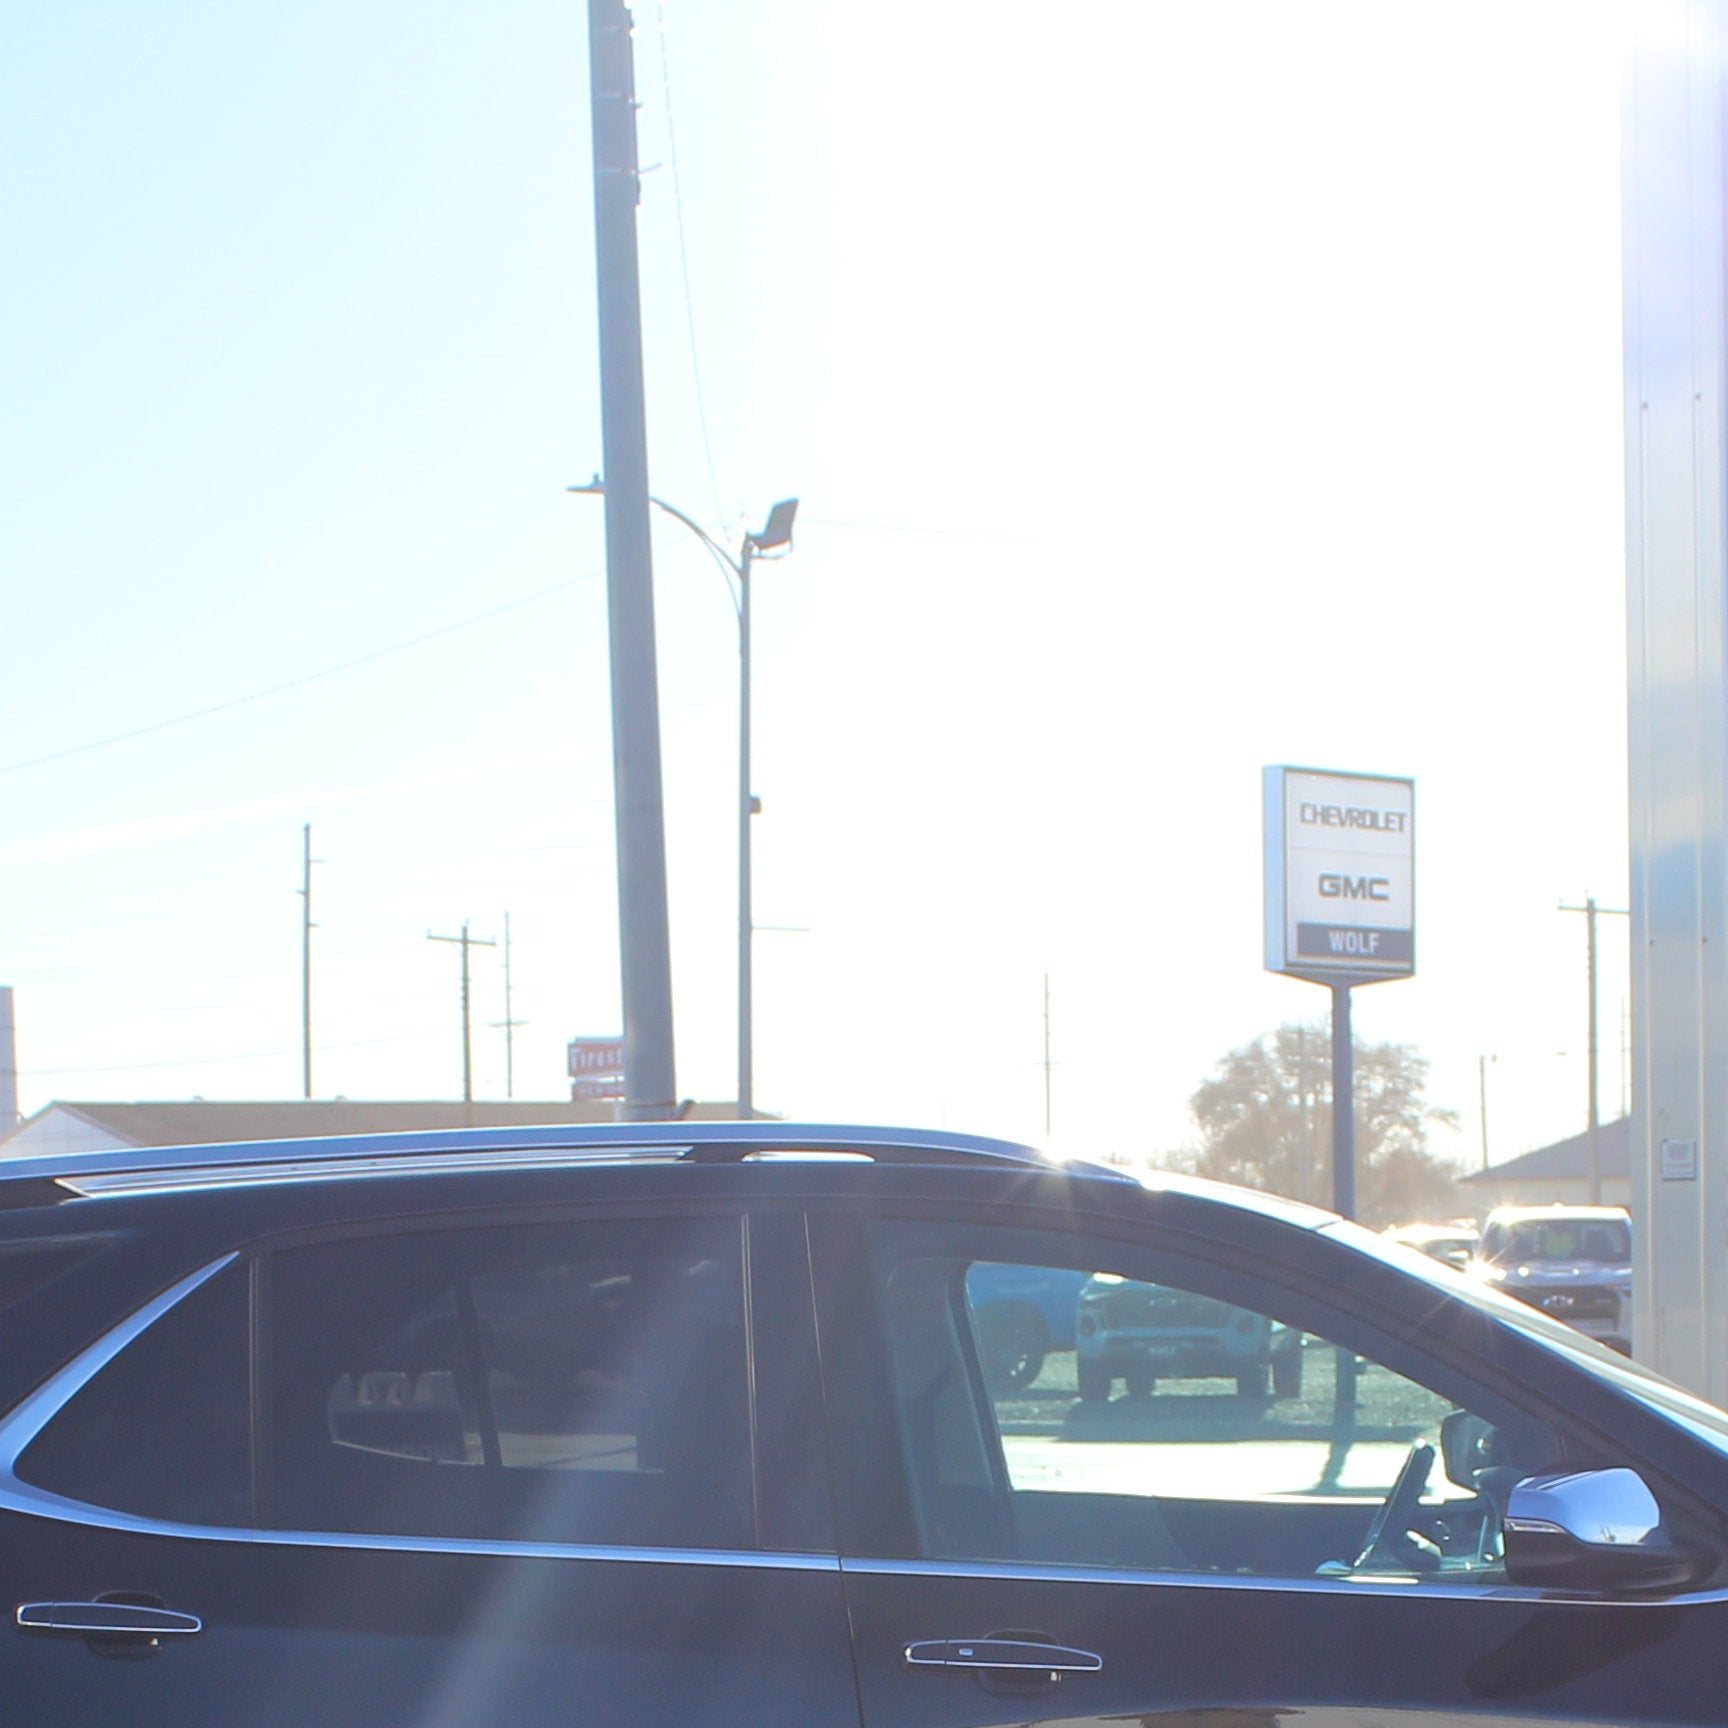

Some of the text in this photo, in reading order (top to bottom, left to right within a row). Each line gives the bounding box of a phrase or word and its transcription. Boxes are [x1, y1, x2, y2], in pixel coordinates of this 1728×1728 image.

[1299, 801, 1407, 833] CHEVROLET
[1318, 871, 1390, 901] GMC
[1329, 929, 1380, 954] WOLF
